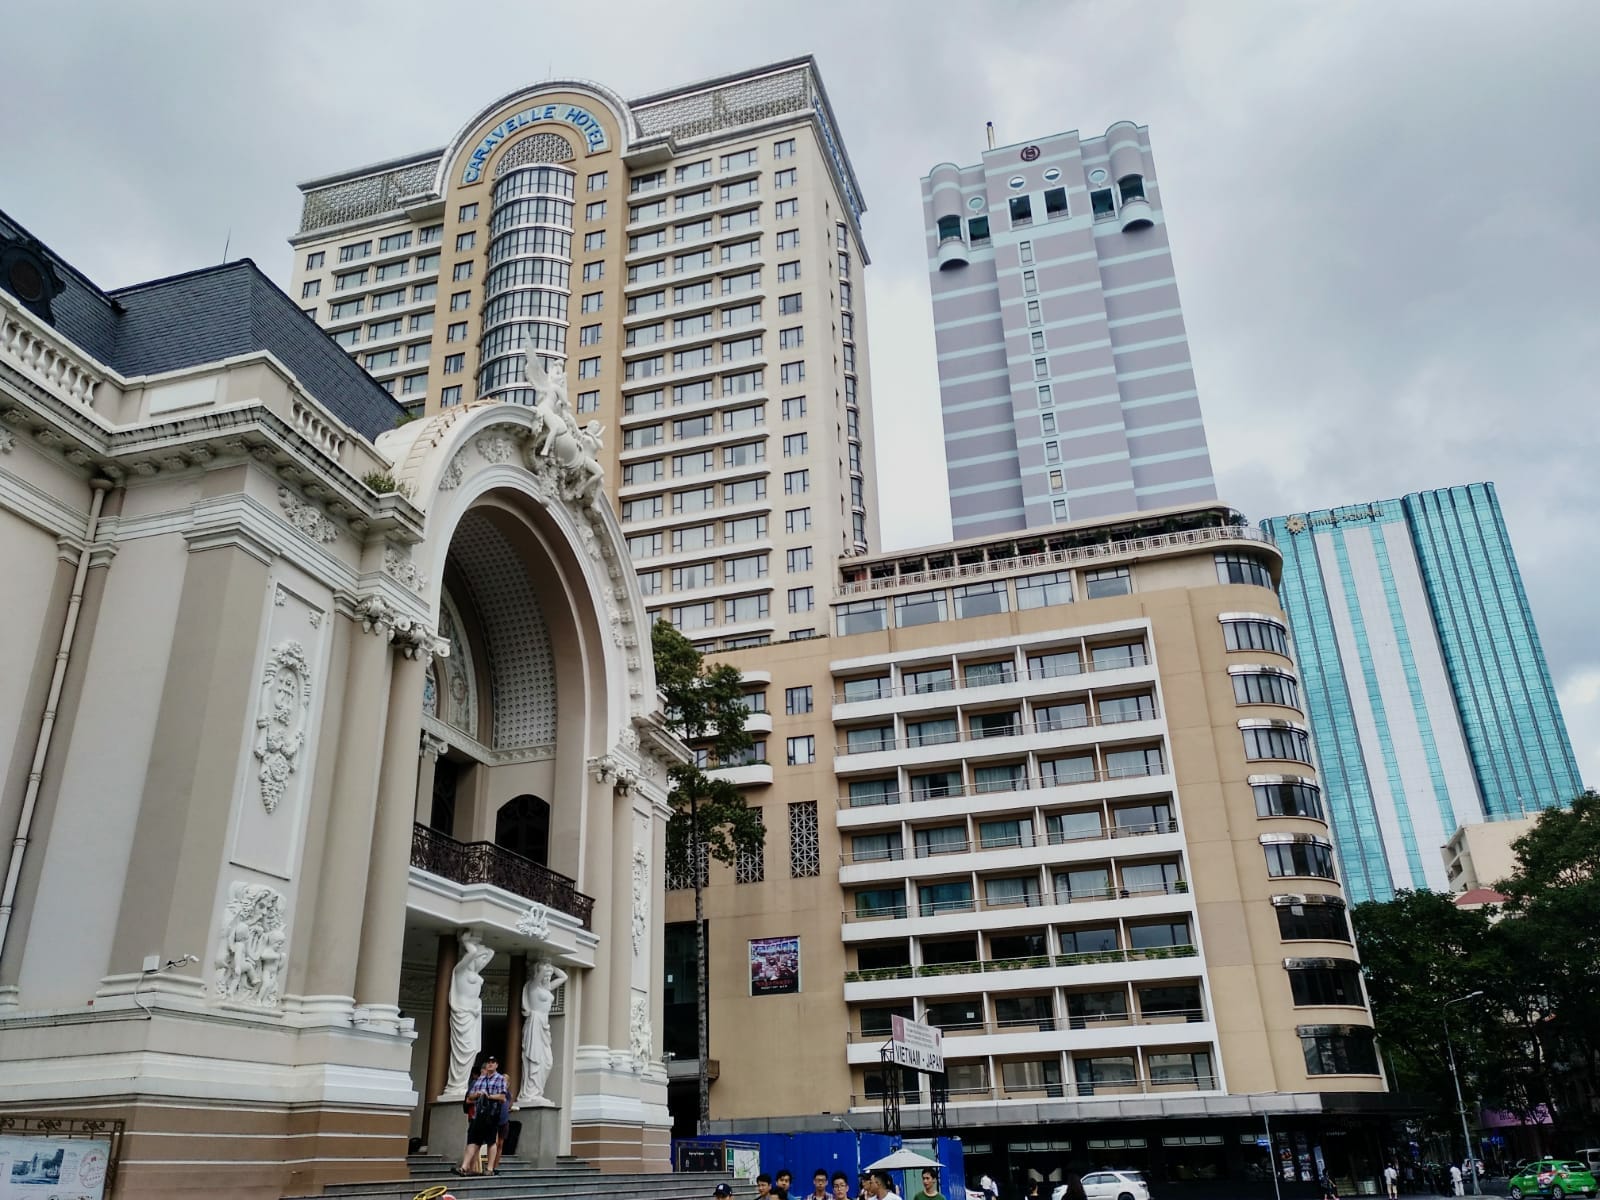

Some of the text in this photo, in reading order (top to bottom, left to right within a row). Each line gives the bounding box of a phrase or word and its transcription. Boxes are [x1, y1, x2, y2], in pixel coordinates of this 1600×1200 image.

[465, 106, 604, 183] CARAVELLE HOTEL
[896, 1045, 921, 1066] VIETNAM
[926, 1053, 943, 1070] JAPAN
